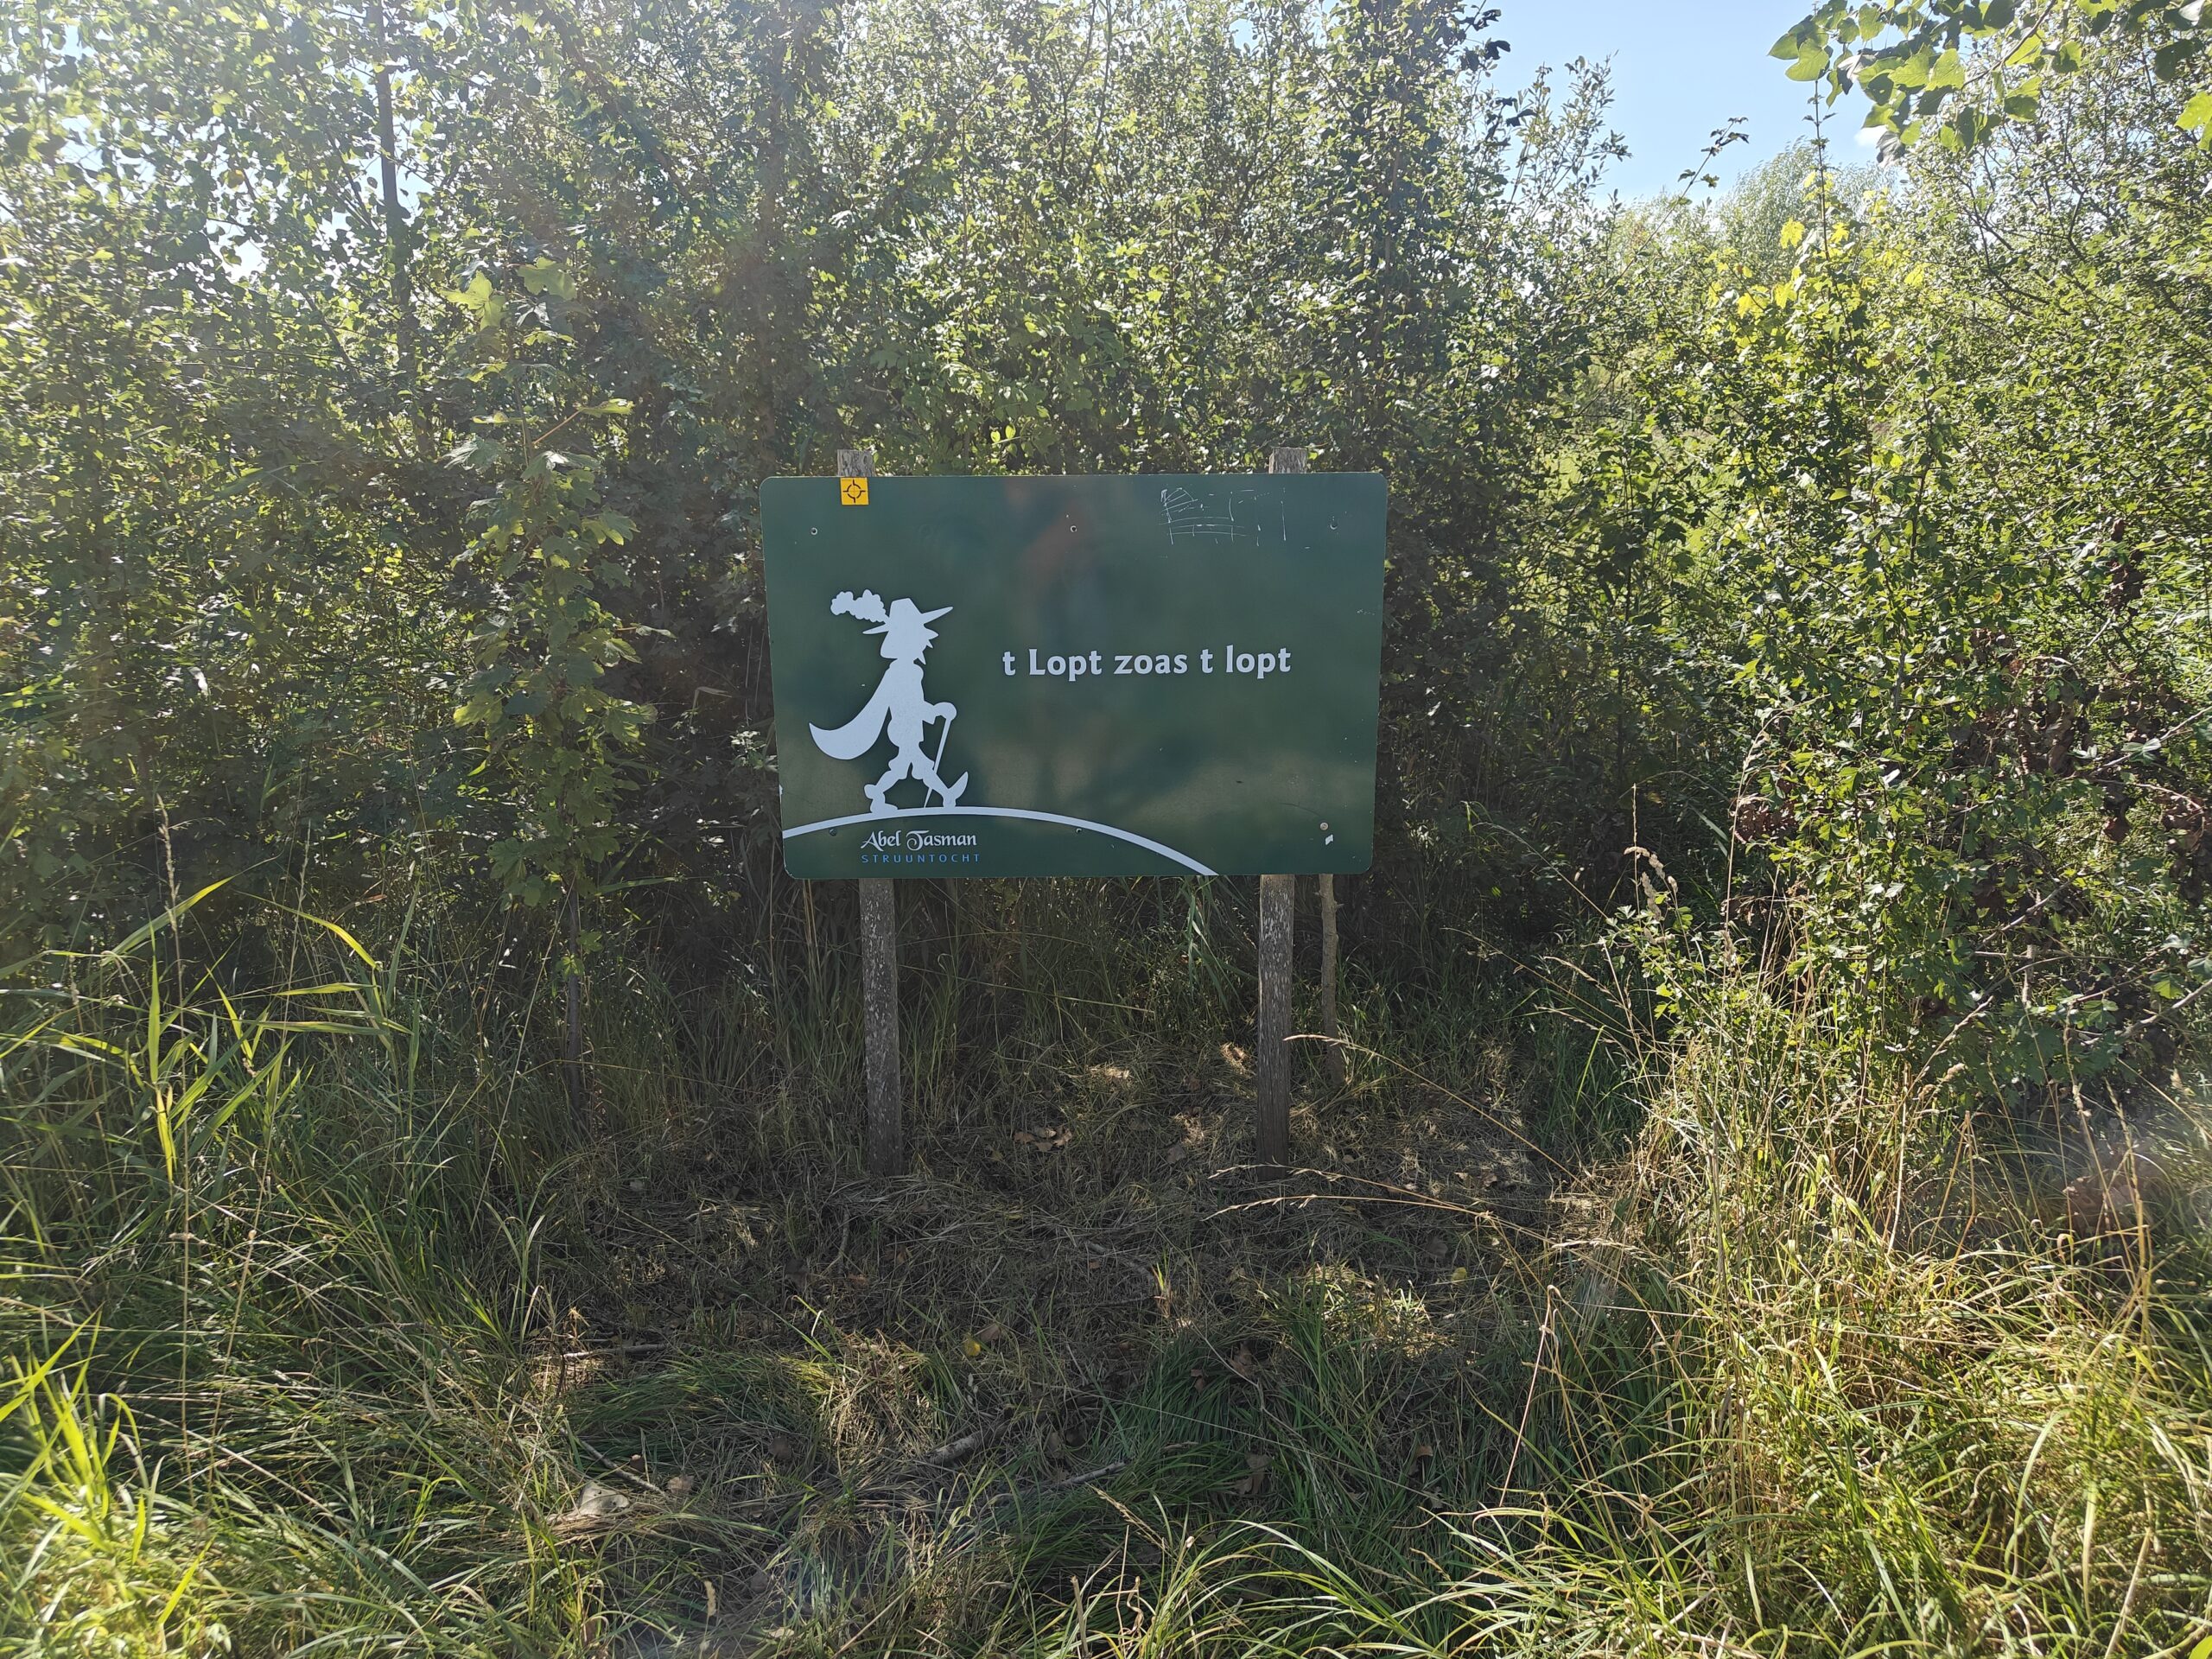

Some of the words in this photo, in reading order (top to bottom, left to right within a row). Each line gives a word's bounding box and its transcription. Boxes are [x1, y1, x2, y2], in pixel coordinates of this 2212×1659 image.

[1002, 651, 1016, 676] t
[1028, 648, 1102, 682] Lopt
[1113, 653, 1188, 674] zoas
[1200, 649, 1213, 674] t
[1226, 645, 1292, 679] lopt
[860, 830, 902, 852] Abel
[906, 830, 977, 851] Tasman
[861, 854, 980, 863] STRUUNTOCHT
